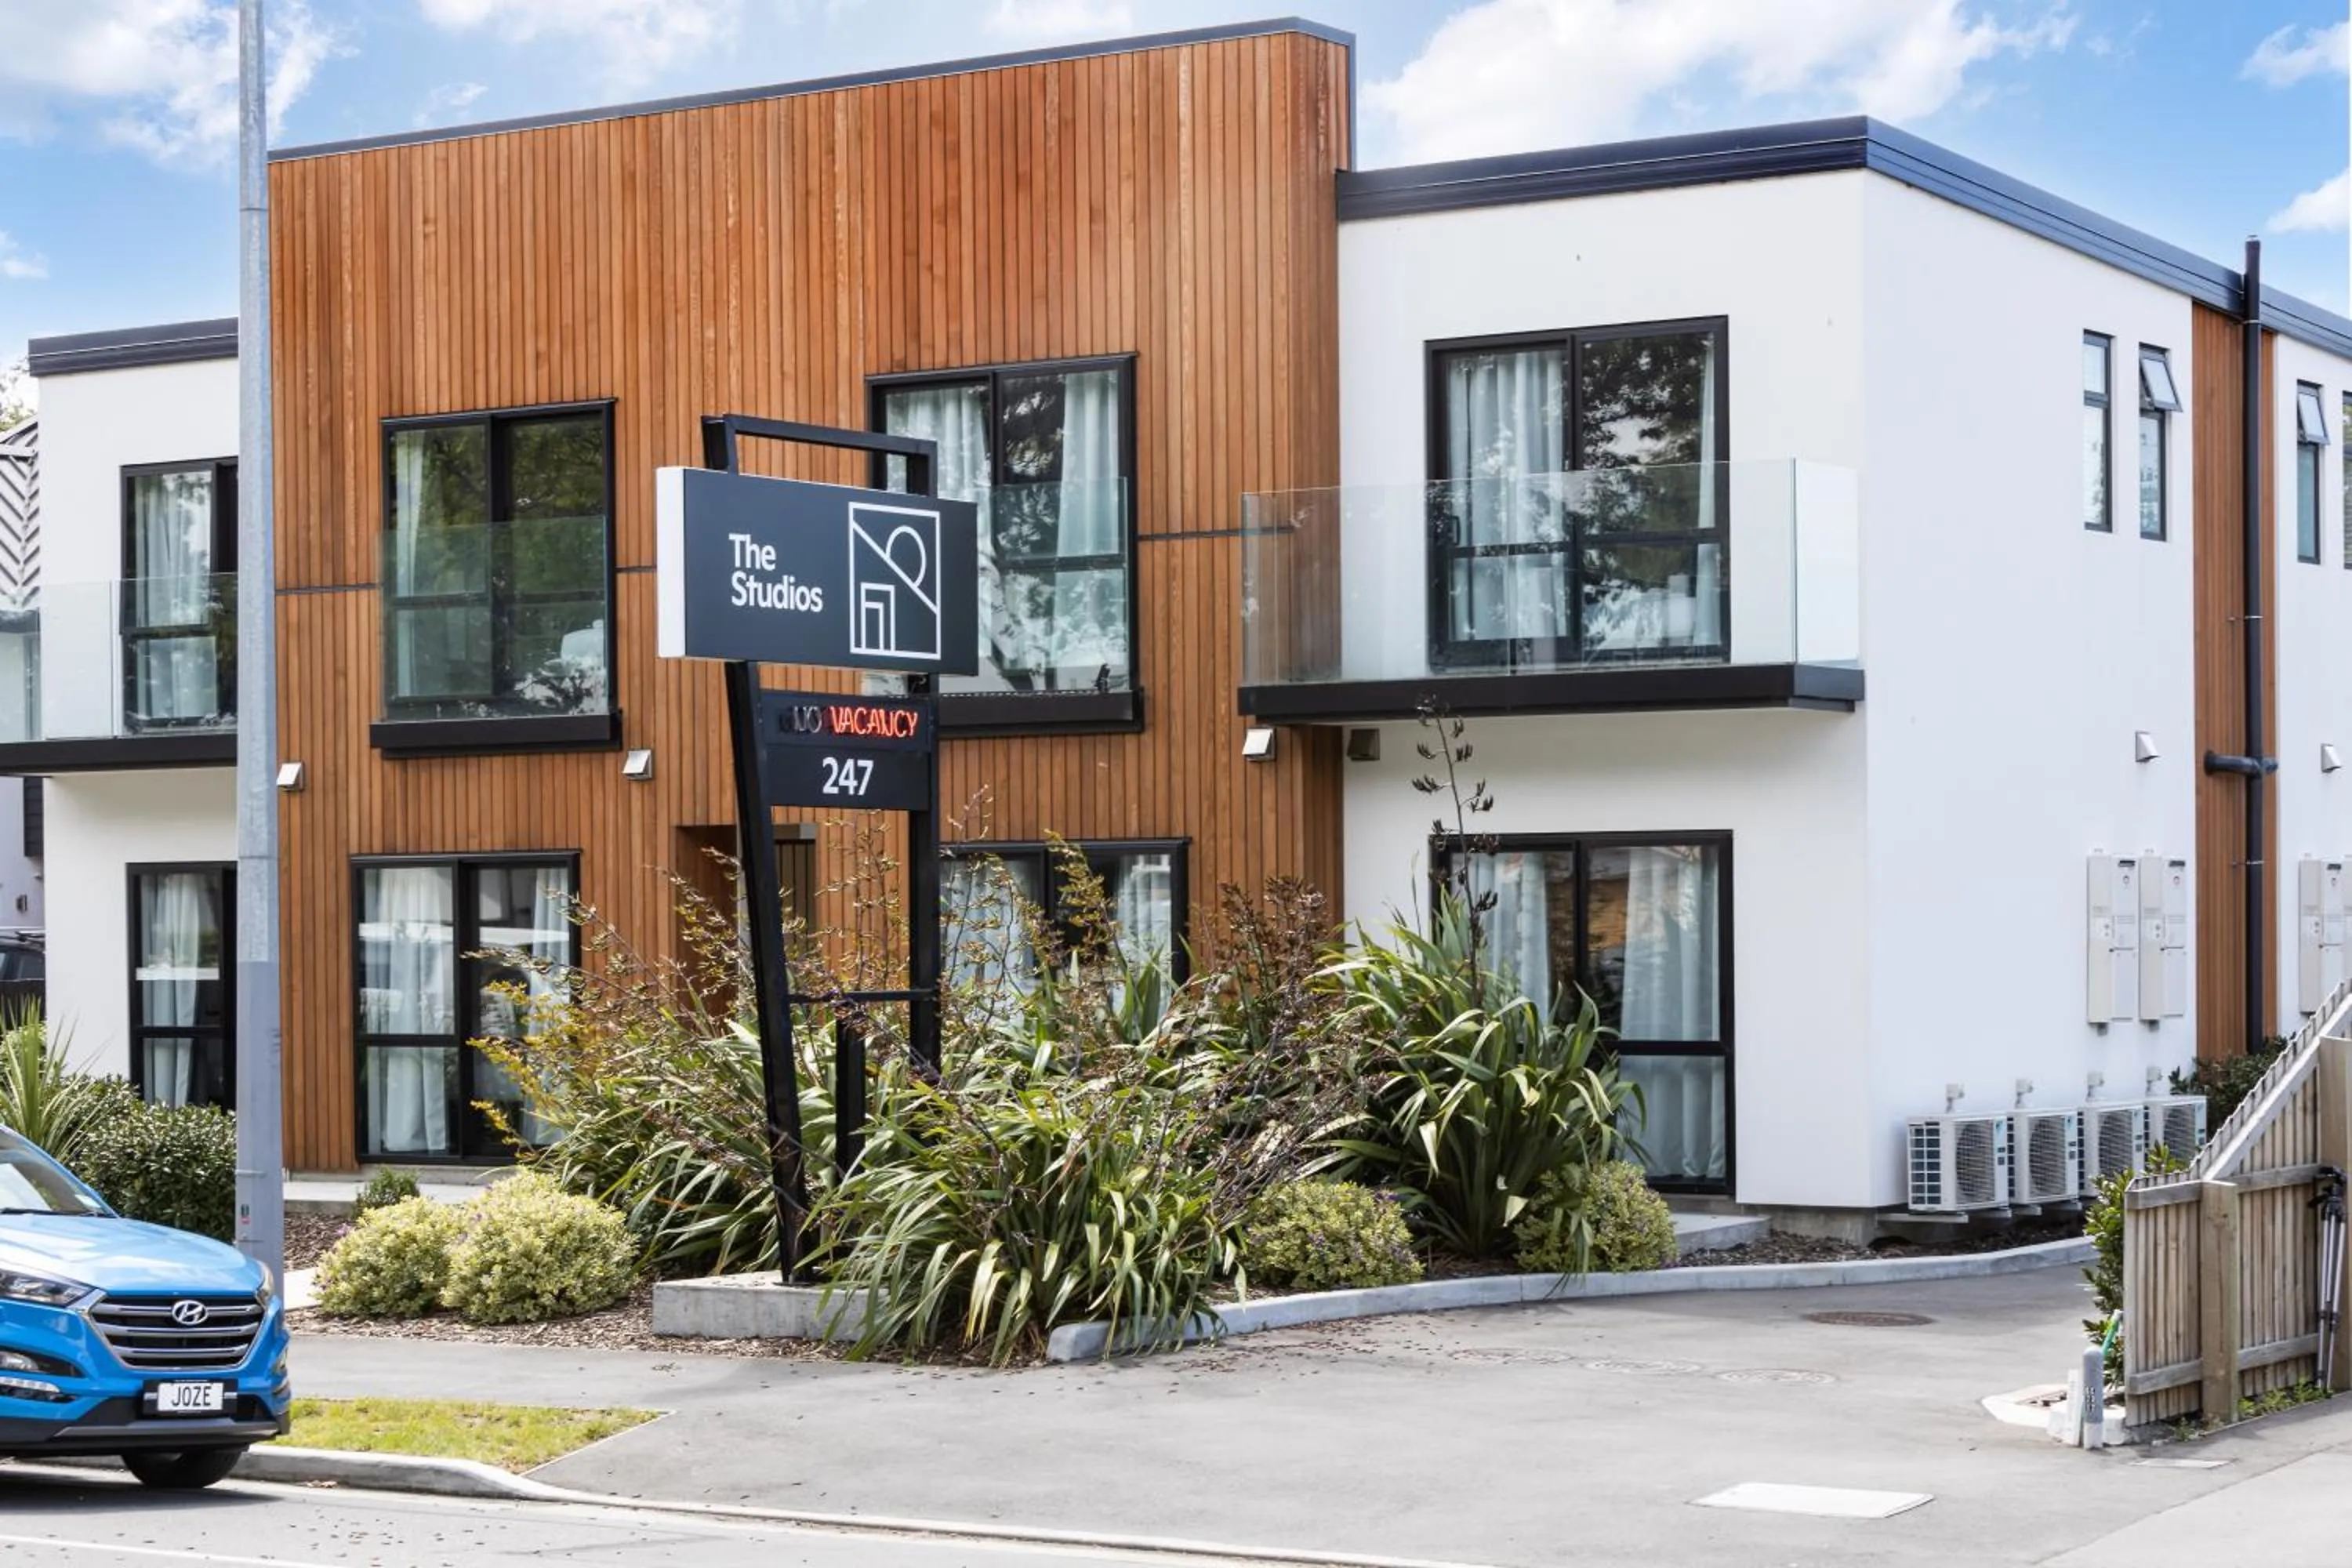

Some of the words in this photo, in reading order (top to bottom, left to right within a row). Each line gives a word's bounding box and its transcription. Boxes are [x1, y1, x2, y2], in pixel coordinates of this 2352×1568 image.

[728, 532, 776, 571] The
[731, 570, 823, 612] Studios
[793, 706, 822, 733] NO
[829, 705, 919, 738] VACANCY
[822, 756, 874, 796] 247
[171, 1385, 212, 1407] JOZE
